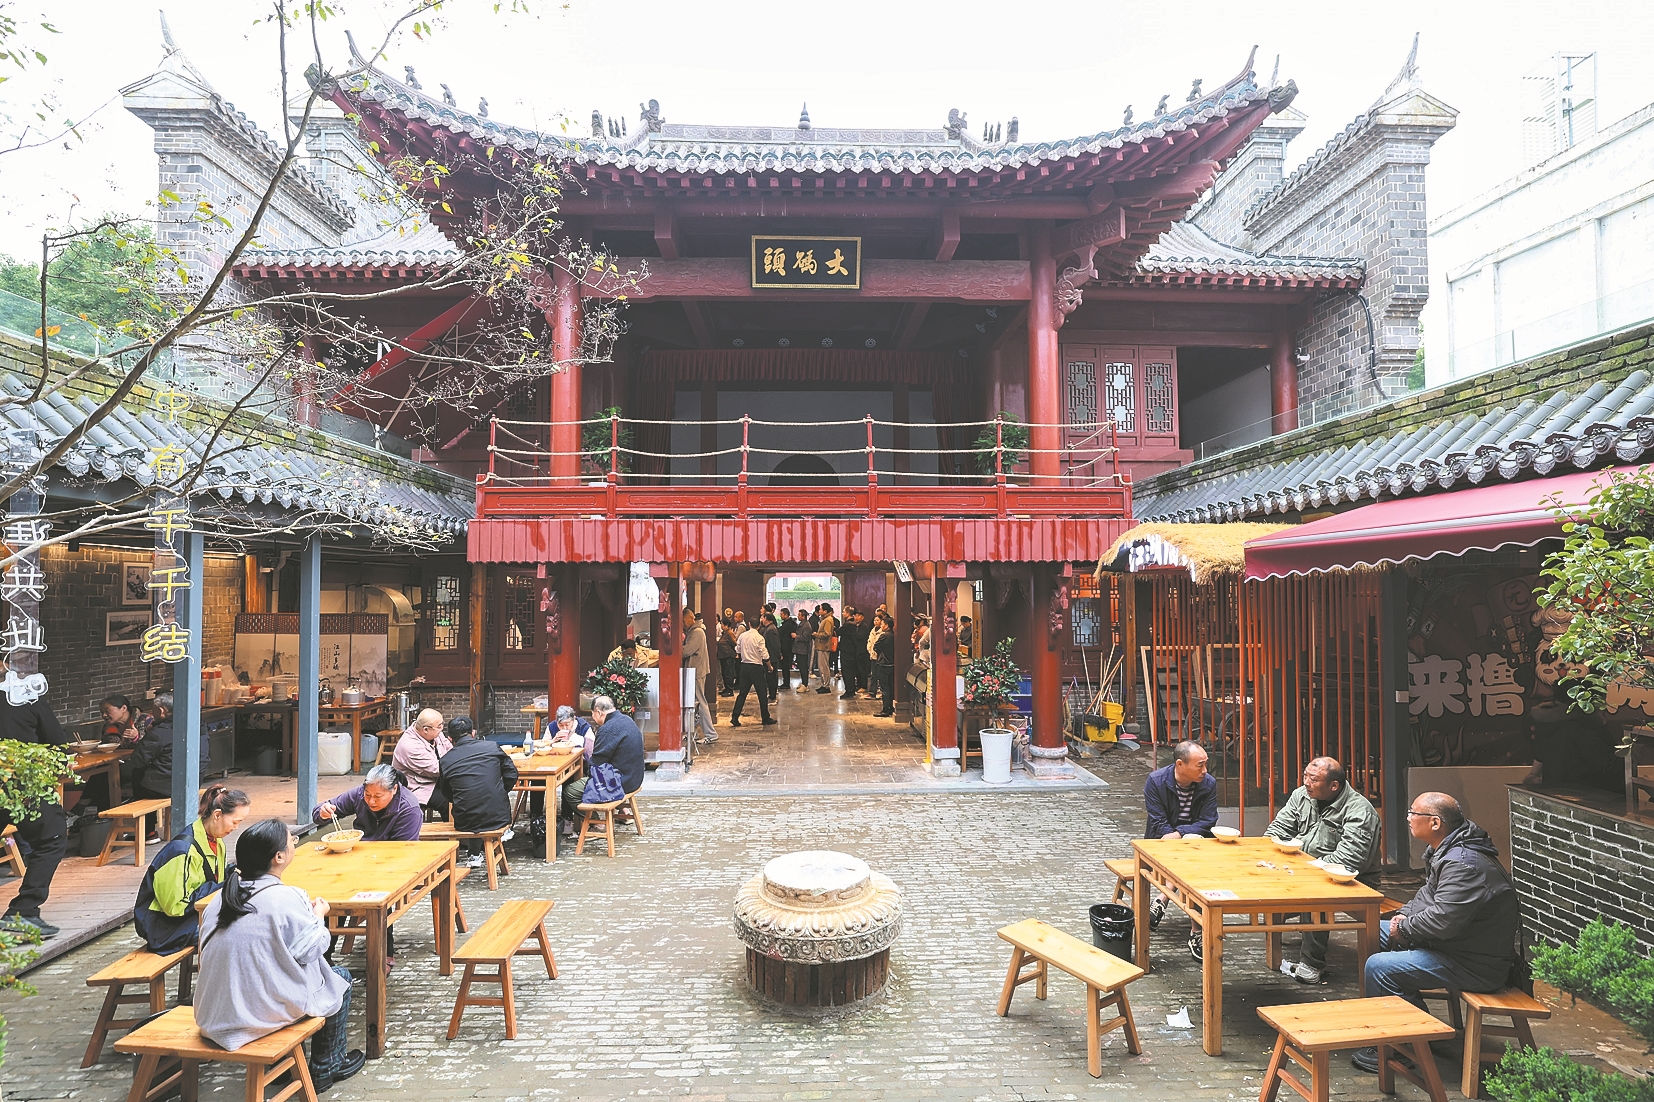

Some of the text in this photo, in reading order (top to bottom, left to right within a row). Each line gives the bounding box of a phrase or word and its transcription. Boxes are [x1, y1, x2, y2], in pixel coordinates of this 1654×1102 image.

[144, 388, 190, 660] 中有千千结
